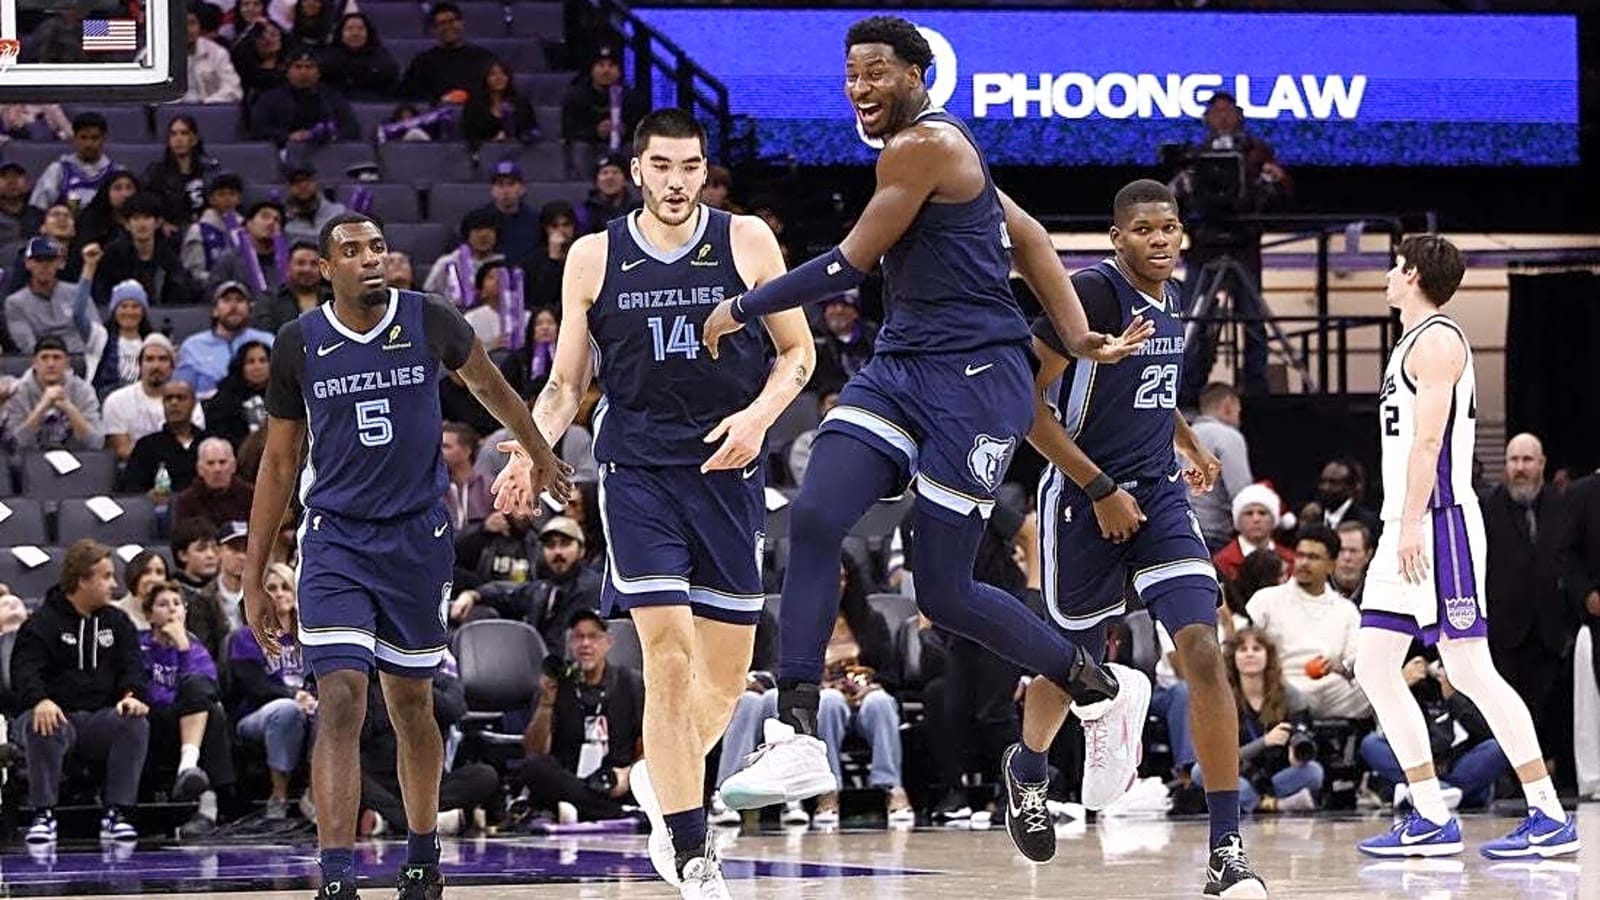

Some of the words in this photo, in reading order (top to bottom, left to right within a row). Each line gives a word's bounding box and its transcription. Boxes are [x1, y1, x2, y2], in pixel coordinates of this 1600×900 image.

[973, 72, 1222, 119] PHOONG
[1235, 74, 1367, 119] LAW
[617, 286, 725, 310] GRIZZLIES
[647, 315, 700, 361] 14
[312, 365, 425, 399] GRIZZLIES
[1133, 364, 1178, 409] 23
[354, 398, 394, 447] 5
